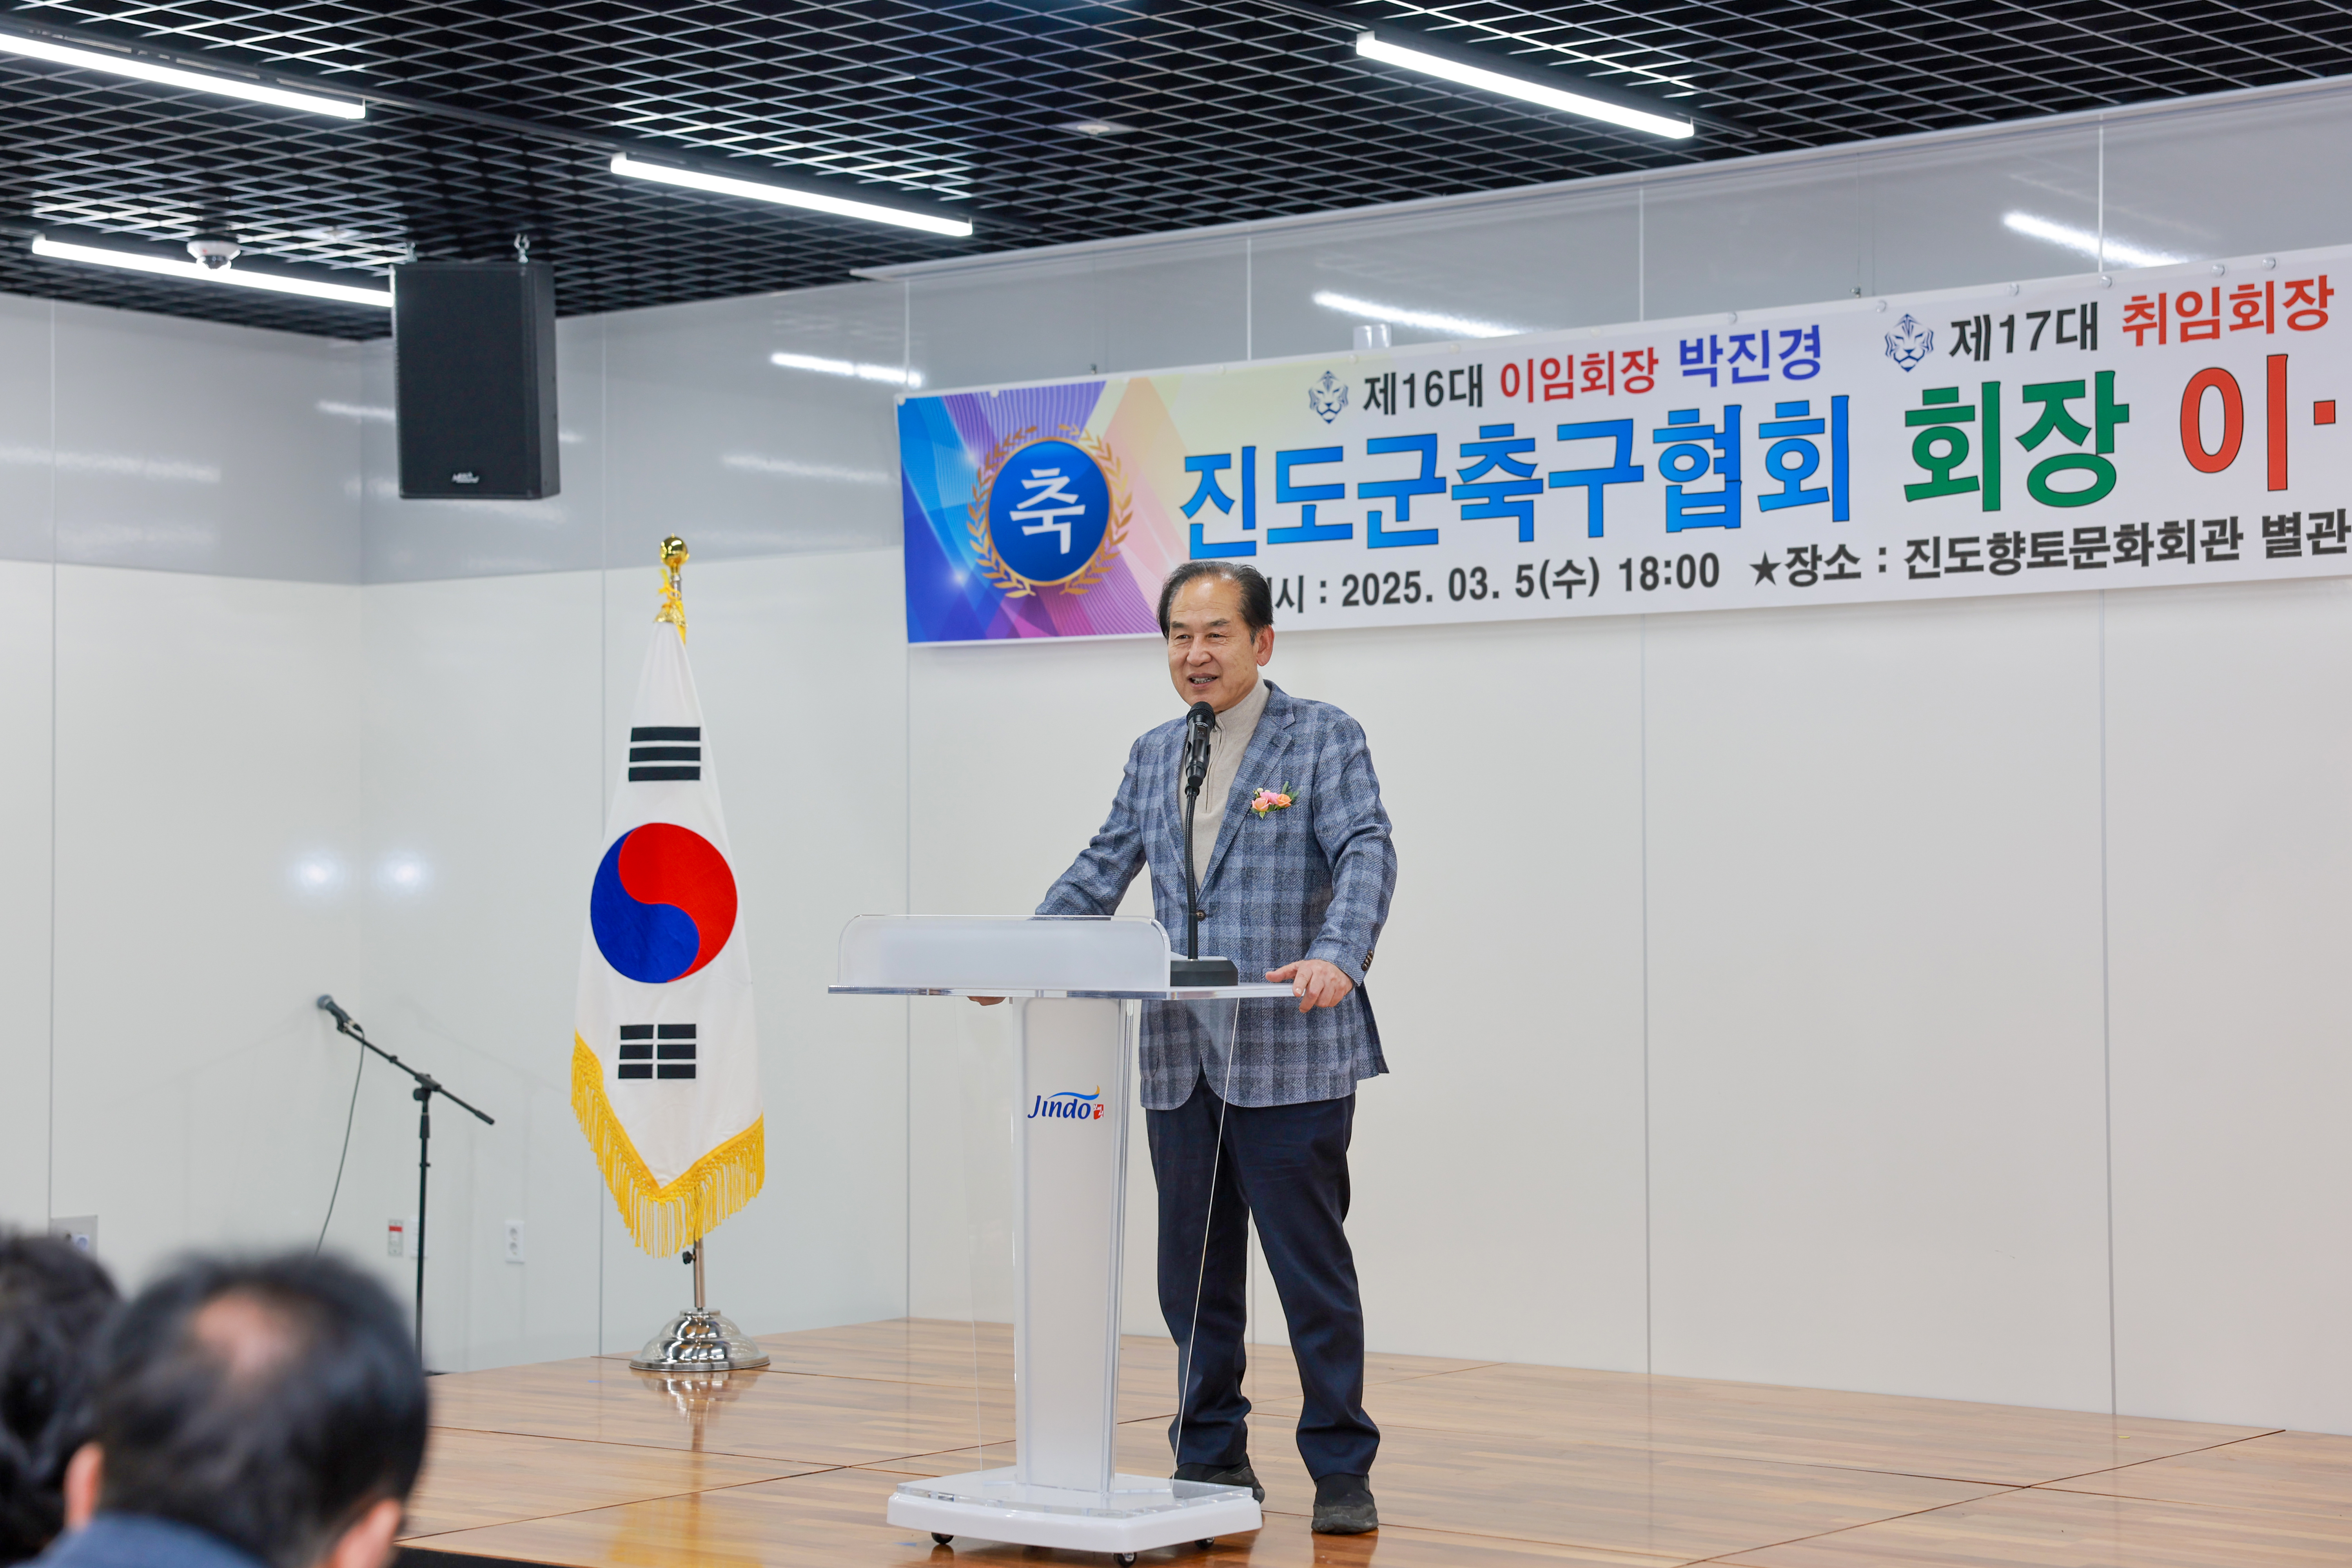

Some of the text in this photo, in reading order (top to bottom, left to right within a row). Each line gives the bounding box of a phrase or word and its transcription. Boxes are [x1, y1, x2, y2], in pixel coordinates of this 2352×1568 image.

[1949, 275, 2334, 361] 제17대 취임회장
[1363, 325, 1821, 416] 제16대 이임회장 박진경
[1180, 395, 1850, 560] 진도군축구협회
[1904, 370, 2129, 512] 회장
[1009, 468, 1085, 555] 축
[1904, 516, 2243, 579] 진도향토문화회관
[2262, 508, 2352, 559] 별관
[1267, 575, 1304, 613] 시
[1342, 571, 1432, 606] 2025.
[1449, 566, 1499, 601] 03.
[1515, 557, 1599, 599] 5(수)
[1619, 553, 1719, 591] 18:00
